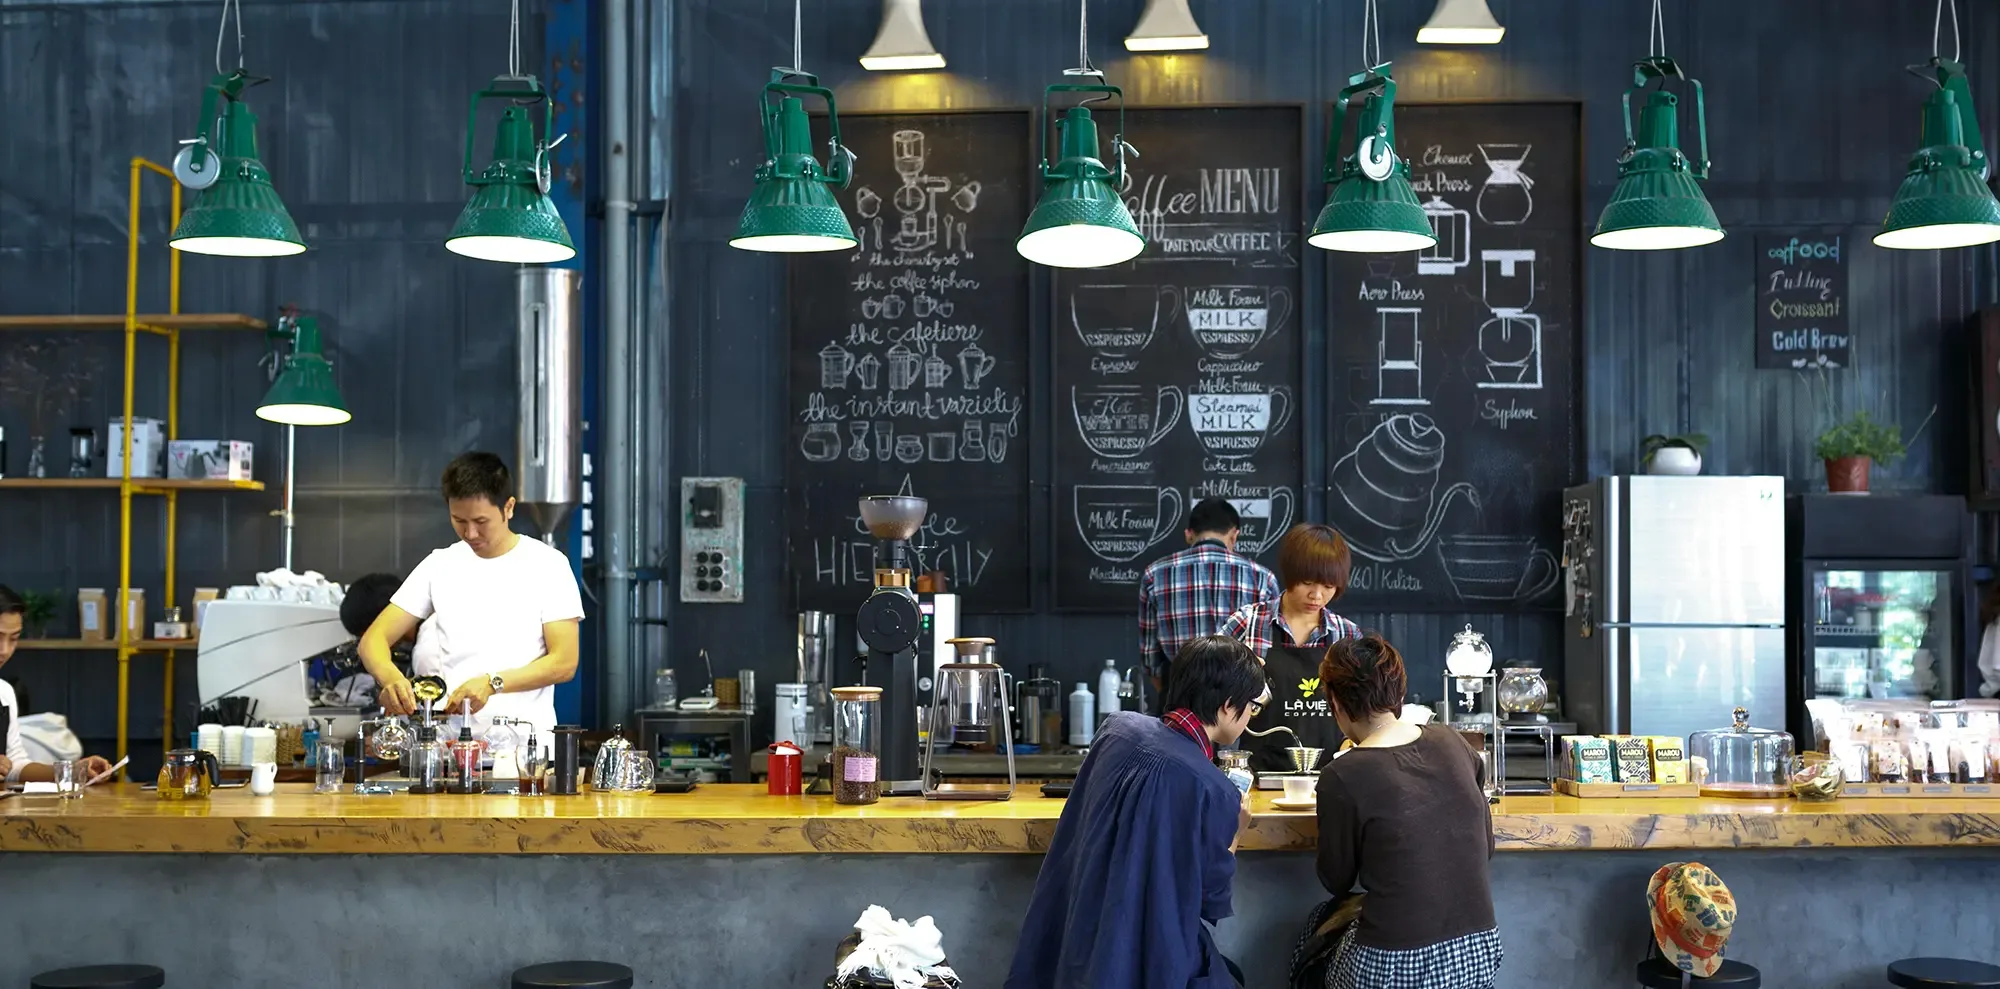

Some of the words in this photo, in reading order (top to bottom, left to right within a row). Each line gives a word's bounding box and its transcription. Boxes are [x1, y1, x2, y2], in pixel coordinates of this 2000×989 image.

[1200, 167, 1280, 214] MENU
[1213, 232, 1272, 253] COFFEE
[851, 272, 885, 291] the
[1193, 288, 1226, 306] Milk
[1769, 297, 1841, 319] Croissant
[1199, 311, 1257, 327] MILK
[845, 323, 884, 346] the
[1772, 328, 1808, 351] Cold
[1811, 327, 1849, 350] Brew
[801, 393, 847, 422] the
[846, 390, 939, 420] instant
[936, 388, 1022, 438] variety
[1081, 414, 1150, 431] WATER
[1201, 414, 1256, 430] MILK
[1202, 478, 1232, 497] Milk
[1088, 510, 1119, 530] Milk
[1284, 699, 1304, 711] LÀ
[1305, 699, 1329, 711] VIỆ
[1583, 749, 1606, 757] MAROU
[1620, 748, 1644, 757] MAROU
[1657, 748, 1681, 757] MAROU
